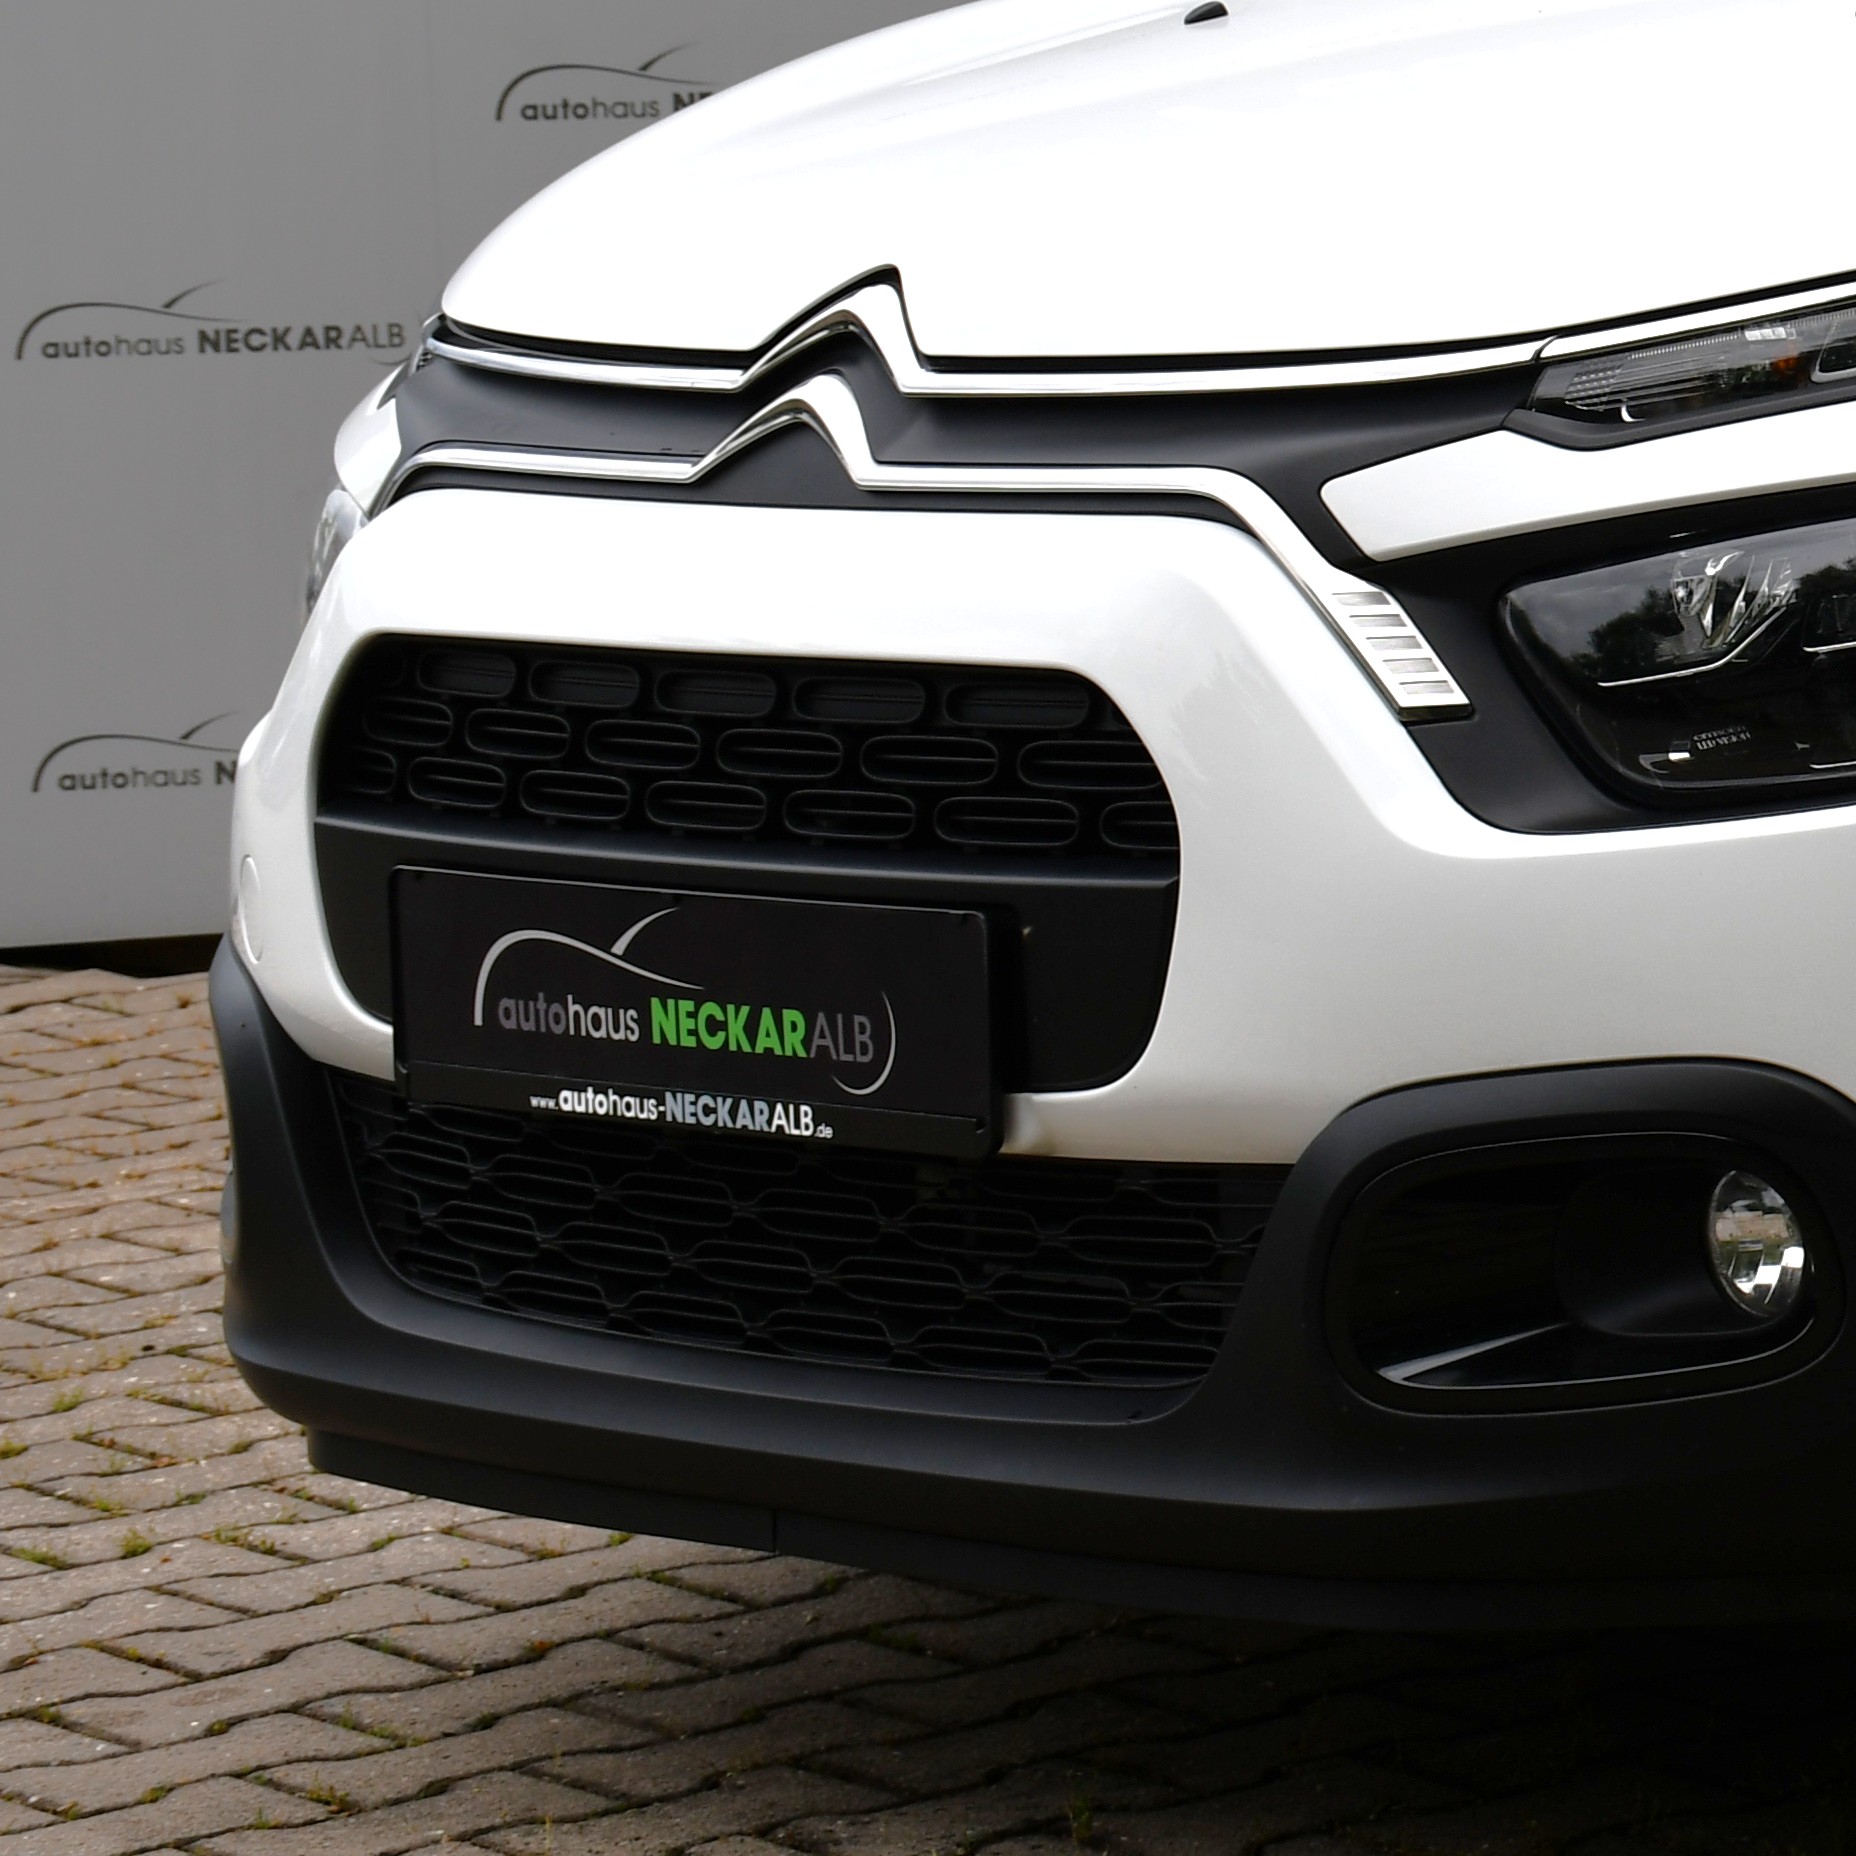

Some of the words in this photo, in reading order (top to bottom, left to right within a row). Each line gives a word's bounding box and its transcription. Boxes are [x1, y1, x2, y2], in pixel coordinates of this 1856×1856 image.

[520, 98, 660, 121] autohaus
[41, 336, 184, 359] autohaus
[198, 323, 405, 354] NECKARALB
[58, 768, 201, 791] autohaus
[498, 992, 640, 1042] autohaus
[650, 996, 874, 1063] NECKARALB
